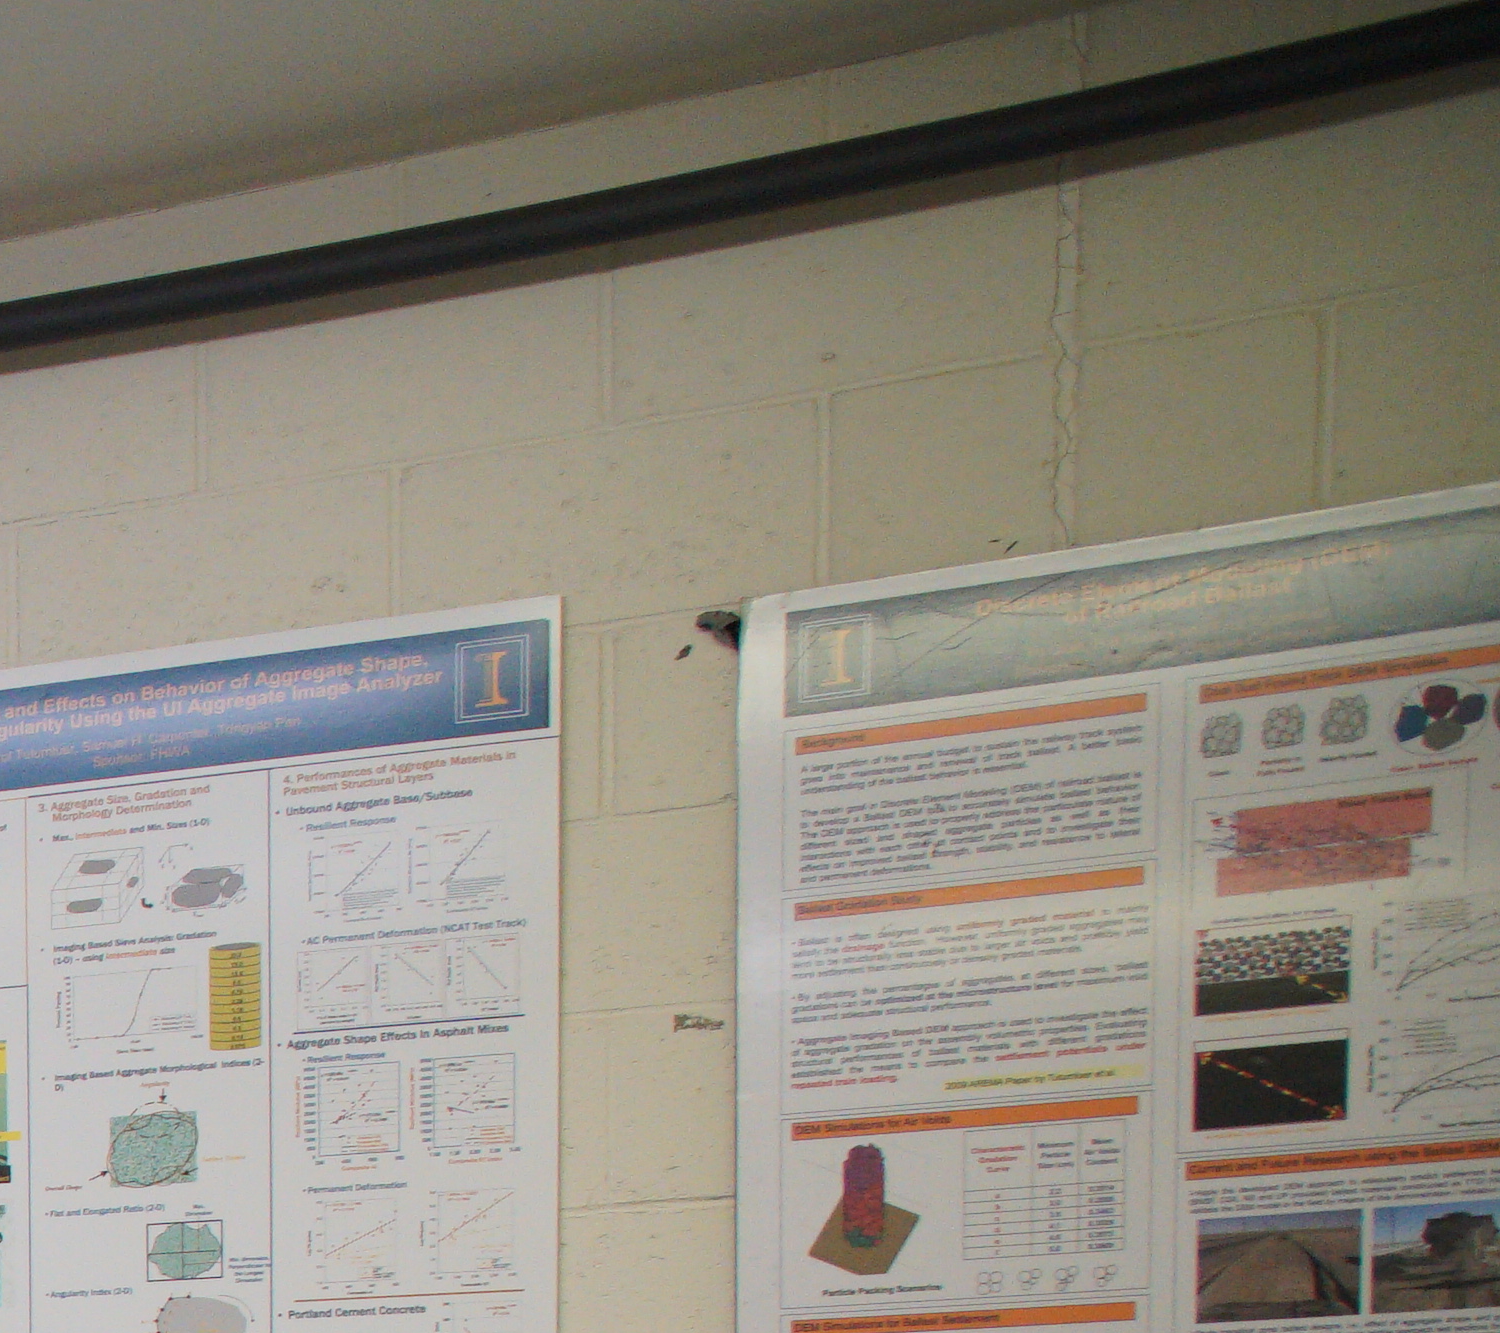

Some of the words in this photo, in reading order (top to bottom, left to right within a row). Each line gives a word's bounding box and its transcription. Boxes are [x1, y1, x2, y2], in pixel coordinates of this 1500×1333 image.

[5, 702, 39, 719] and
[43, 692, 106, 714] Effects
[112, 691, 135, 705] on
[141, 677, 225, 700] Behavior
[229, 673, 251, 691] of
[254, 663, 354, 689] Aggregate
[70, 708, 122, 732] Using
[128, 704, 156, 721] the
[162, 696, 183, 715] UI
[188, 689, 286, 717] Aggregate
[292, 682, 350, 702] Image
[356, 670, 444, 695] Analyzer
[283, 776, 293, 784] 4.
[297, 766, 373, 784] Performances
[376, 763, 387, 774] of
[390, 757, 446, 775] Aggregate
[450, 752, 503, 766] Materials
[283, 783, 338, 796] Pavement
[341, 776, 394, 790] Structural
[399, 772, 434, 785] Layers
[38, 804, 48, 813] 3.
[50, 797, 104, 813] Aggregate
[134, 788, 187, 802] Gradation
[190, 785, 210, 795] and
[52, 806, 113, 823] Morphology
[115, 798, 192, 815] Determination
[286, 803, 333, 817] Unbound
[335, 797, 390, 813] Aggregate
[393, 788, 473, 805] Base/Subbase
[129, 825, 145, 834] and
[167, 820, 187, 830] Sizes
[306, 820, 347, 833] Resilient
[350, 815, 397, 828] Response
[53, 942, 86, 953] Imaging
[88, 940, 113, 950] Based
[176, 930, 217, 942] Gradation
[307, 935, 319, 945] AC
[322, 929, 374, 944] Permanent
[378, 925, 438, 940] Deformation
[473, 920, 493, 931] Test
[496, 918, 527, 930] Track)
[287, 1036, 341, 1051] Aggregate
[343, 1032, 377, 1046] Shape
[380, 1029, 417, 1042] Effects
[433, 1025, 474, 1039] Asphalt
[477, 1023, 509, 1034] Mixes
[54, 1072, 87, 1082] Imaging
[90, 1070, 114, 1079] Based
[116, 1066, 157, 1079] Aggregate
[160, 1060, 217, 1073] Morphological
[307, 1184, 353, 1195] Permanent
[355, 1181, 407, 1192] Deformation
[66, 1209, 81, 1217] and
[83, 1206, 121, 1217] Elongated
[51, 1288, 89, 1299] Angularity
[91, 1288, 112, 1296] Index
[288, 1309, 332, 1320] Portland
[335, 1307, 376, 1318] Cement
[379, 1305, 427, 1316] Concrete
